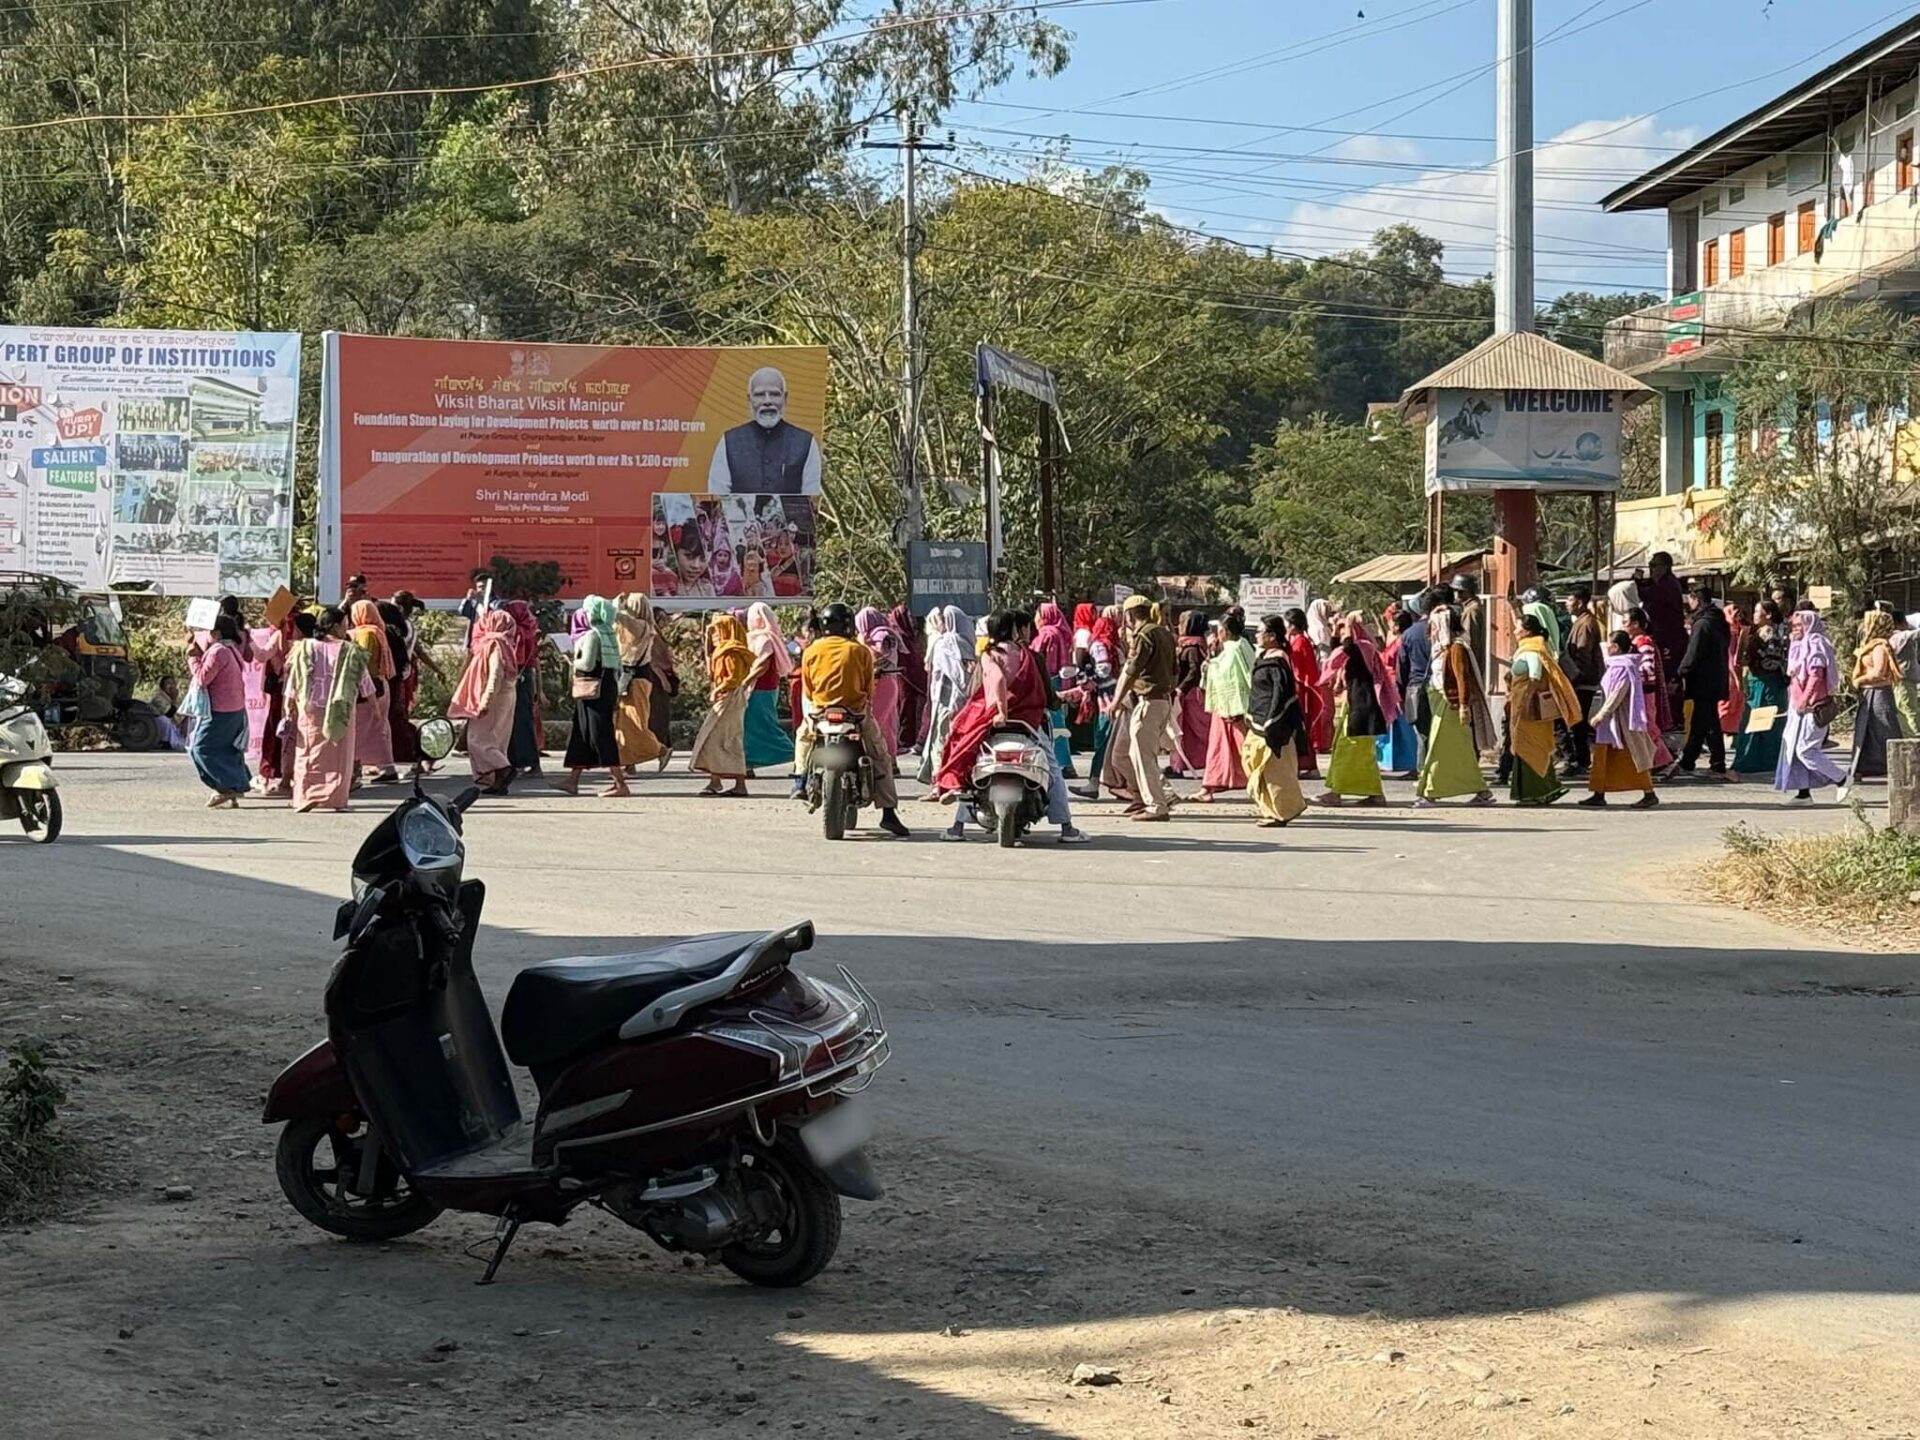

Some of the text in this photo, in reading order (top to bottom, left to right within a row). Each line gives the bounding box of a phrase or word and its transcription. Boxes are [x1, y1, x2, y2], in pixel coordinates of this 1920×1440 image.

[0, 343, 277, 368] PERT GROUP OF INSTITUTIONS
[434, 394, 625, 415] Viksit Bharat Viksit Manipur
[1504, 389, 1613, 413] WELCOME
[62, 414, 99, 426] HURRY
[354, 412, 408, 426] Foundation
[409, 413, 437, 427] Stone
[439, 414, 470, 429] Laying
[471, 414, 485, 428] for
[486, 415, 549, 430] Development
[550, 416, 589, 431] Projects
[592, 417, 619, 430] worth
[621, 419, 641, 431] over
[643, 419, 655, 431] Rs
[681, 420, 706, 432] crore
[64, 422, 93, 437] UP!
[577, 434, 605, 443] Manipur
[43, 449, 96, 465] SALIENT
[371, 450, 439, 464] Inauguration
[441, 451, 452, 463] of
[453, 451, 520, 465] Development
[522, 452, 564, 467] Projects
[566, 453, 595, 466] worth
[597, 455, 619, 466] over
[620, 454, 633, 467] Rs
[662, 455, 689, 467] crore
[48, 469, 95, 485] FEATURES
[476, 489, 589, 501] Shri Narendra Modi
[522, 504, 541, 512] Prime
